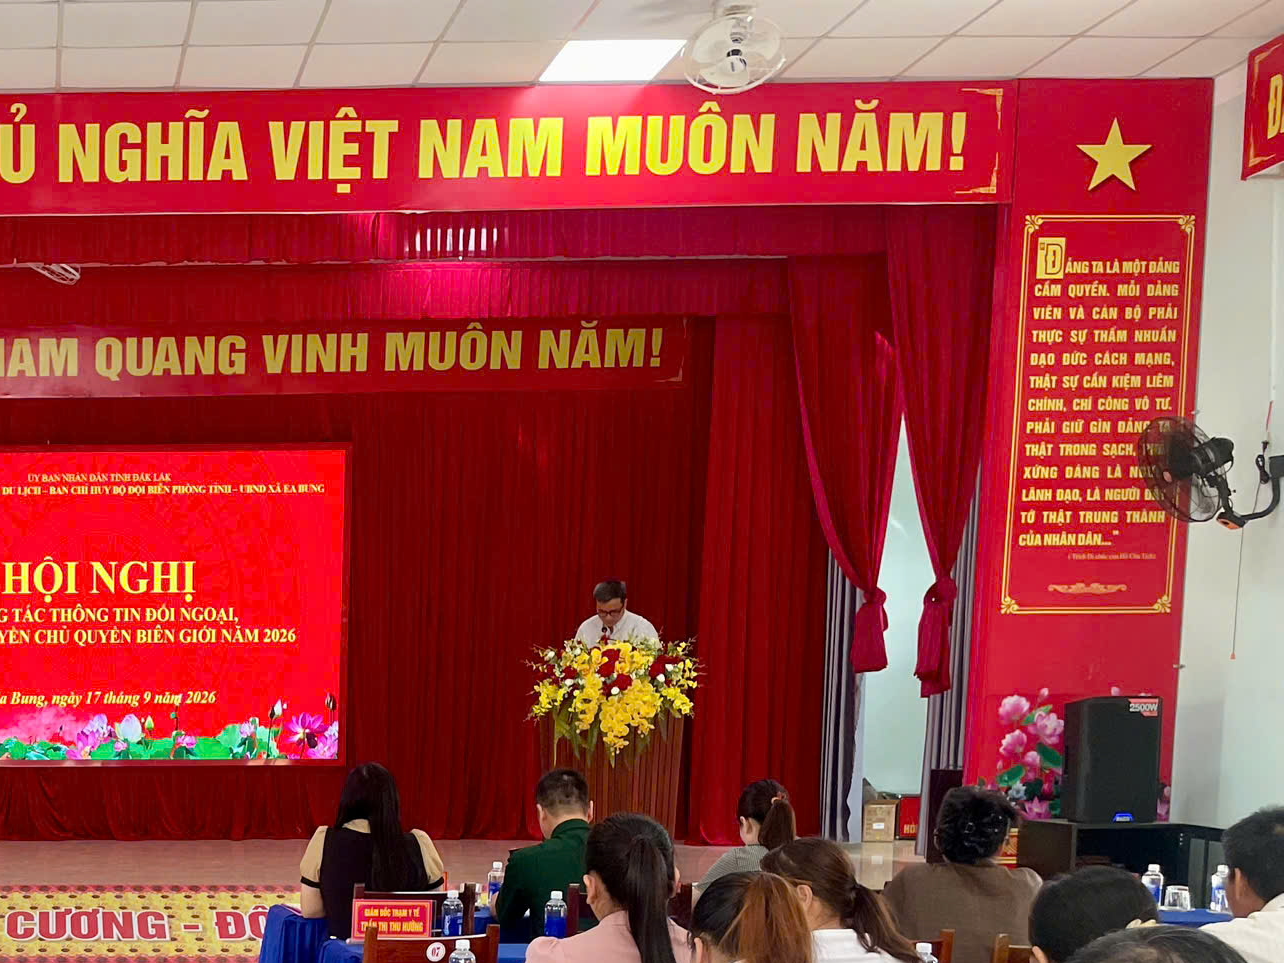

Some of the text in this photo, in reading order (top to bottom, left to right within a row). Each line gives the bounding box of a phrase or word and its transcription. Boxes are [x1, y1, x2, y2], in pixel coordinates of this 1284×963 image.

[58, 108, 248, 183] NGHĨA
[268, 106, 399, 194] VIỆT
[417, 117, 564, 179] NAM
[585, 101, 776, 177] MUÔN
[796, 97, 968, 173] NĂM!
[1033, 303, 1178, 322] VIÊN VÀ CÁN BỘ PHẢI
[94, 335, 246, 382] QUANG
[262, 333, 368, 374] VINH
[384, 322, 522, 371] MUÔN
[538, 321, 663, 370] NĂM!
[1030, 351, 1174, 368] ĐẠO ĐỨC CÁCH MẠNG,
[1029, 373, 1058, 391] THẬT
[1062, 375, 1080, 391] SỰ
[1112, 373, 1141, 390] KIỆM
[1146, 373, 1174, 388] LIÊM
[1028, 396, 1066, 412] CHÍNH,
[1073, 396, 1092, 411] CHÍ
[1098, 396, 1129, 411] CÔNG
[1135, 396, 1149, 411] VÔ
[42, 474, 61, 482] BAN
[2, 487, 17, 496] DU
[50, 487, 69, 495] BAN
[90, 487, 111, 495] HUY
[239, 485, 266, 493] UBND
[283, 484, 296, 493] EA
[1020, 509, 1165, 526] TỚ THẬT TRUNG THÀNH
[1019, 530, 1042, 546] CỦA
[1044, 531, 1076, 546] NHÂN
[2, 556, 196, 603] HỘI NGHỊ
[12, 604, 45, 622] TÁC
[49, 603, 109, 622] THÔNG
[113, 608, 141, 622] TIN
[145, 604, 175, 622] ĐỐI
[180, 607, 239, 624] NGOẠI,
[35, 626, 70, 644] CHỦ
[74, 626, 131, 646] QUYỀN
[136, 625, 175, 643] BIÊN
[179, 625, 216, 643] GIỚI
[221, 626, 259, 642] NĂM
[263, 628, 296, 643] 2026
[10, 691, 49, 708] Bung,
[51, 693, 82, 708] ngày
[86, 691, 101, 704] 17
[104, 691, 140, 707] tháng
[144, 691, 151, 704] 9
[154, 692, 182, 704] năm
[186, 690, 216, 704] 2026
[1129, 703, 1158, 712] 2500W
[4, 907, 172, 942] CƯƠNG
[430, 947, 441, 957] 07
